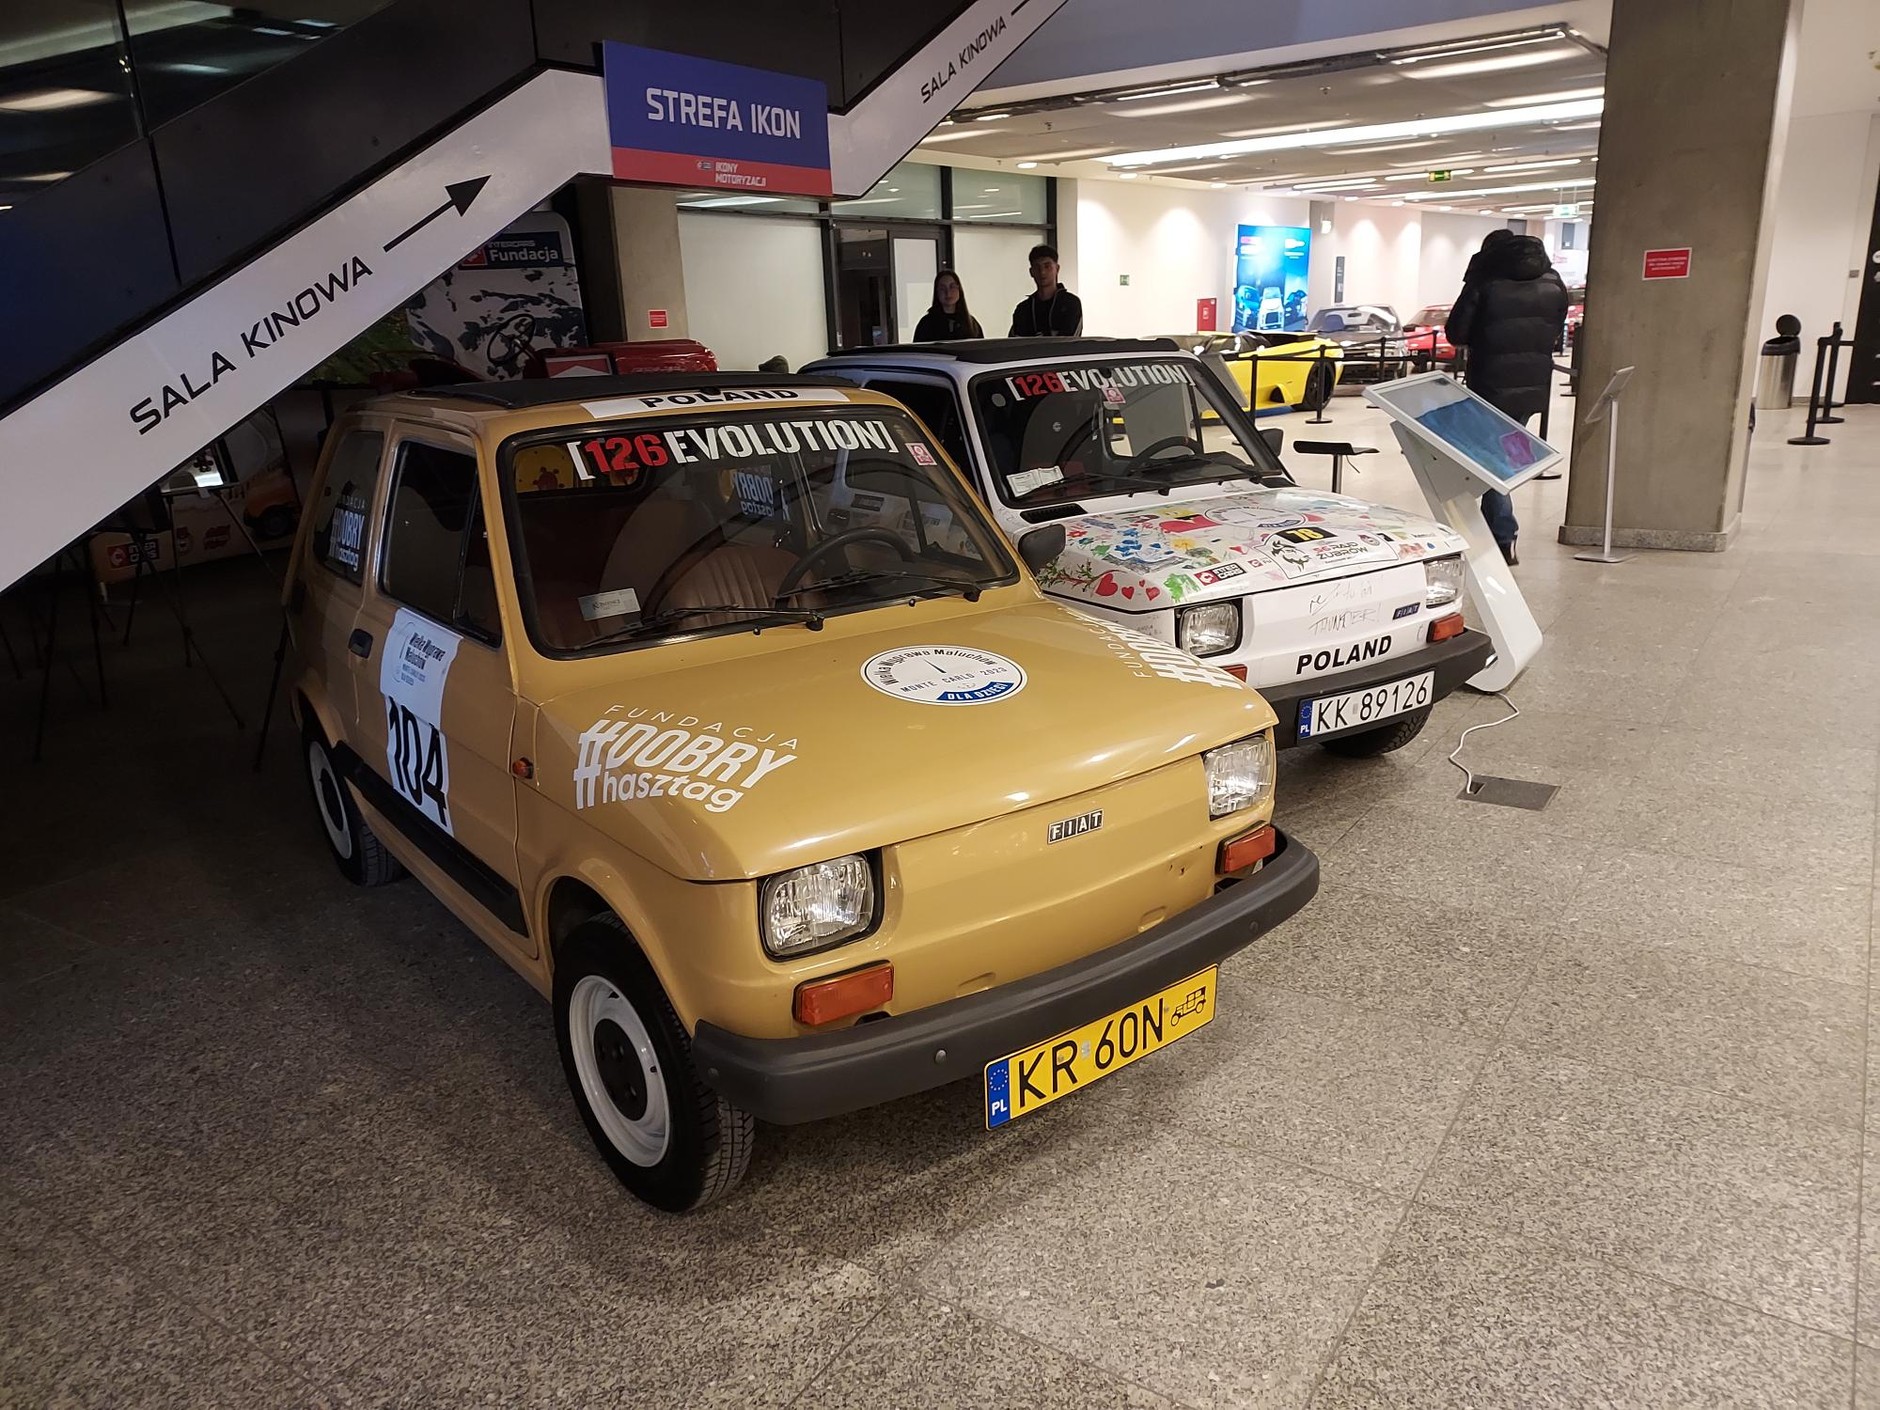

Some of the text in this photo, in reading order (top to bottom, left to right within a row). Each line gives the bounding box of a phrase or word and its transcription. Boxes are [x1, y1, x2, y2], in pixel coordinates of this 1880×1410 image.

[920, 15, 1007, 104] SALA KINOWA
[646, 87, 801, 139] STREFA IKON
[715, 161, 739, 173] IKONY
[715, 173, 767, 187] MOTORYZACJI
[490, 246, 559, 263] Fundacja
[129, 255, 374, 436] SALA KINOWA
[638, 388, 800, 408] POLAND
[1296, 635, 1392, 675] POLAND
[900, 681, 938, 692] MONTE
[941, 673, 975, 683] CARLO
[974, 682, 1009, 698] DZIECI
[1317, 676, 1429, 732] KK 89126
[604, 704, 798, 749] FUNDACJA
[1300, 725, 1310, 733] PL
[388, 695, 448, 827] 104
[573, 719, 797, 810] #DOBRY
[602, 771, 745, 812] hasztag
[1052, 811, 1102, 841] FIAT
[1019, 998, 1164, 1108] KR 60N
[991, 1099, 1008, 1116] PL
